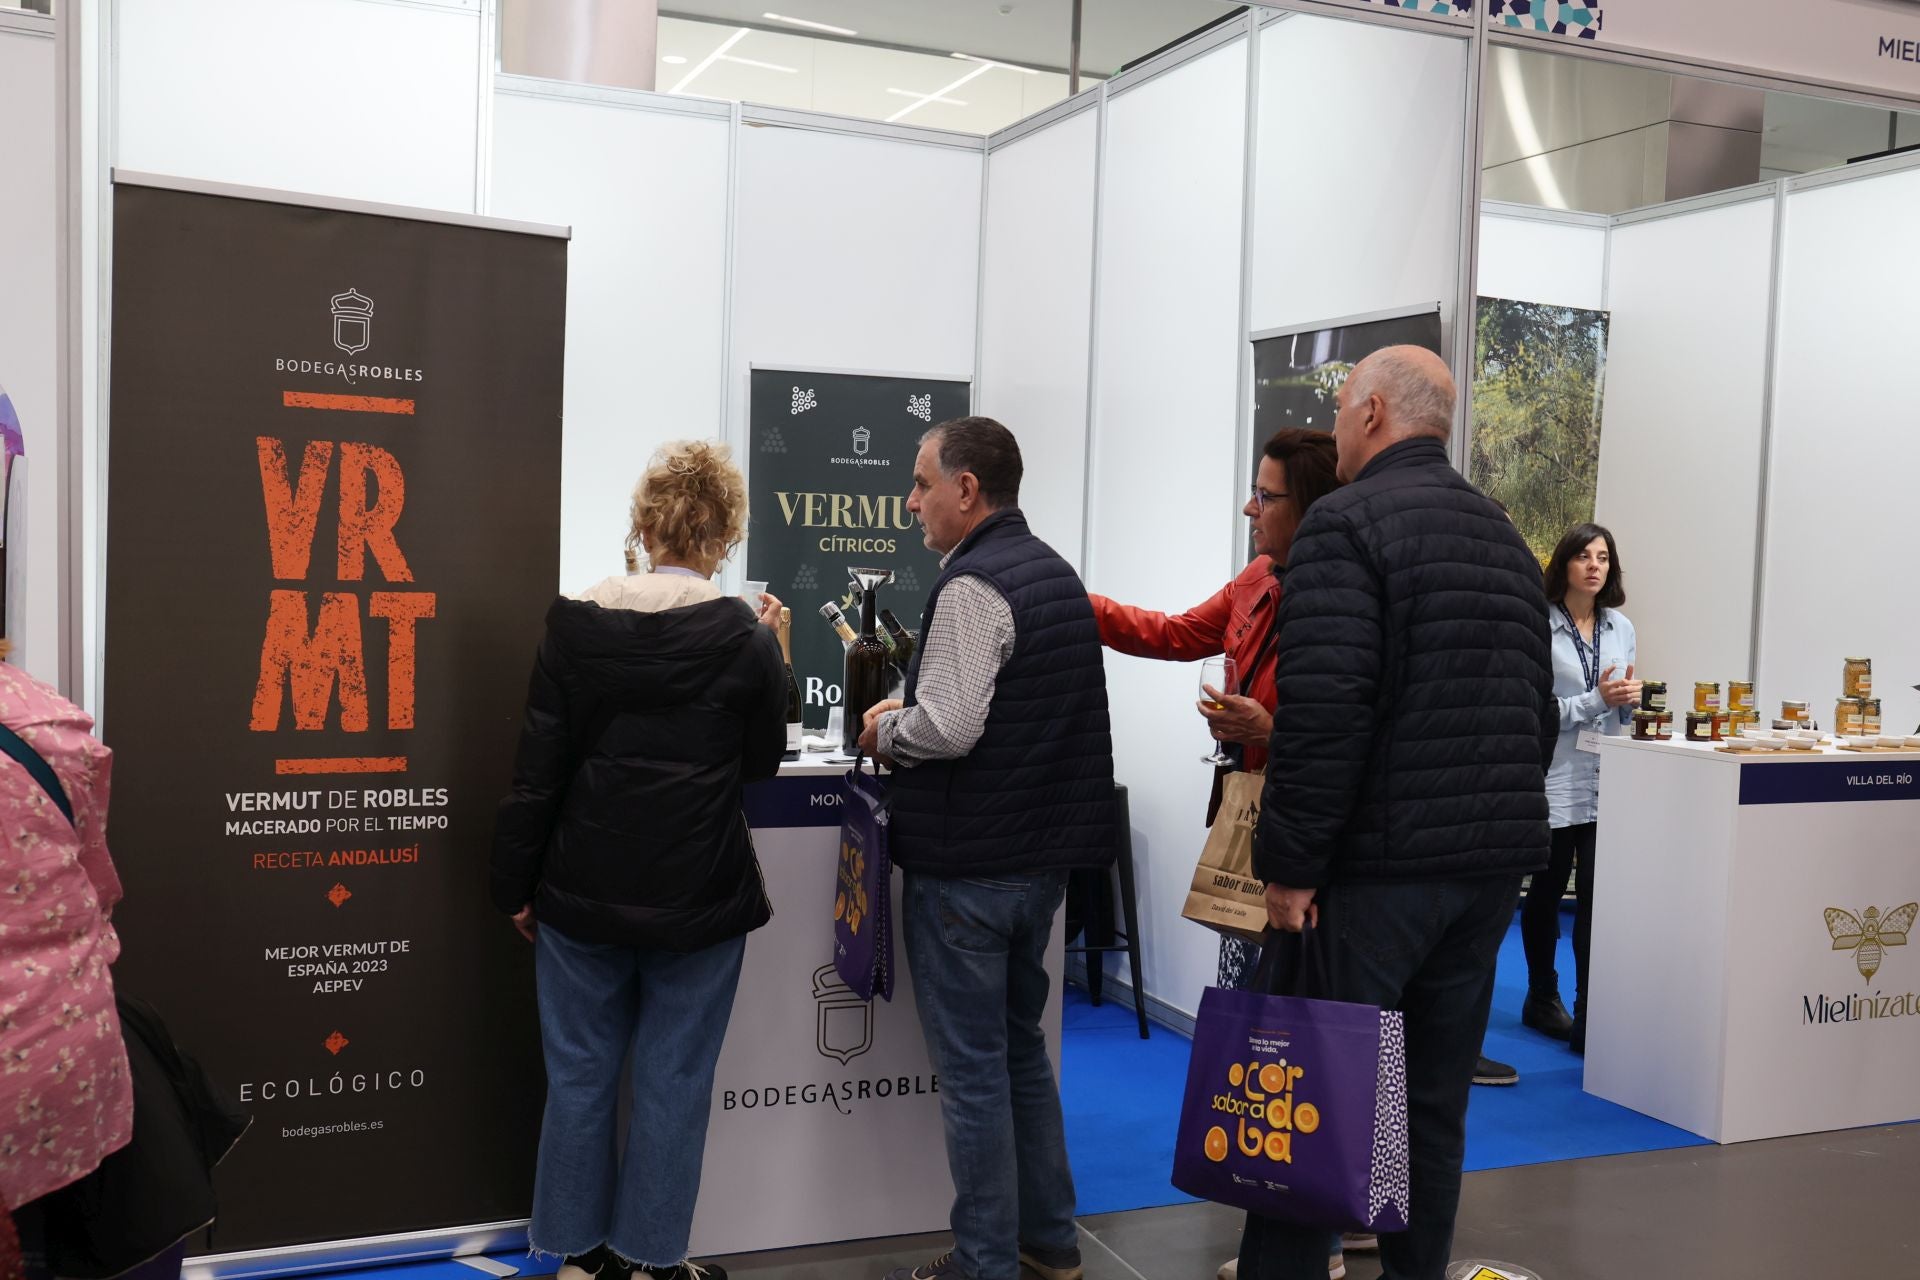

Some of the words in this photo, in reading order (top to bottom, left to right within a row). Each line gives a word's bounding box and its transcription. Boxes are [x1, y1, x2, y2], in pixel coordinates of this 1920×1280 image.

[256, 435, 416, 583] VR
[773, 491, 914, 530] VERMU
[819, 534, 896, 553] CÍTRICOS
[248, 588, 437, 733] MT
[805, 676, 843, 707] Ro
[1846, 775, 1873, 786] VILLA
[1876, 775, 1894, 785] DEL
[1896, 772, 1913, 784] RÍO
[225, 790, 322, 812] VERMUT
[328, 790, 357, 810] DE
[363, 788, 449, 808] ROBLES
[810, 793, 844, 807] MON
[225, 819, 321, 836] MACERADO
[325, 818, 359, 833] POR
[364, 817, 384, 832] EL
[387, 815, 449, 831] TIEMPO
[253, 852, 325, 869] RECETA
[328, 843, 420, 866] ANDALUSÍ
[1212, 874, 1241, 891] sabor
[265, 945, 319, 961] MEJOR
[321, 941, 387, 958] VERMUT
[390, 940, 410, 953] DE
[288, 960, 348, 978] ESPAÑA
[352, 959, 388, 975] 2023
[312, 978, 363, 994] AEPEV
[240, 1069, 425, 1102] ECOLÓGICO
[723, 1074, 939, 1115] BODEGASROBLE
[1211, 1091, 1249, 1115] sabor
[281, 1119, 384, 1139] bodegasrobles.es
